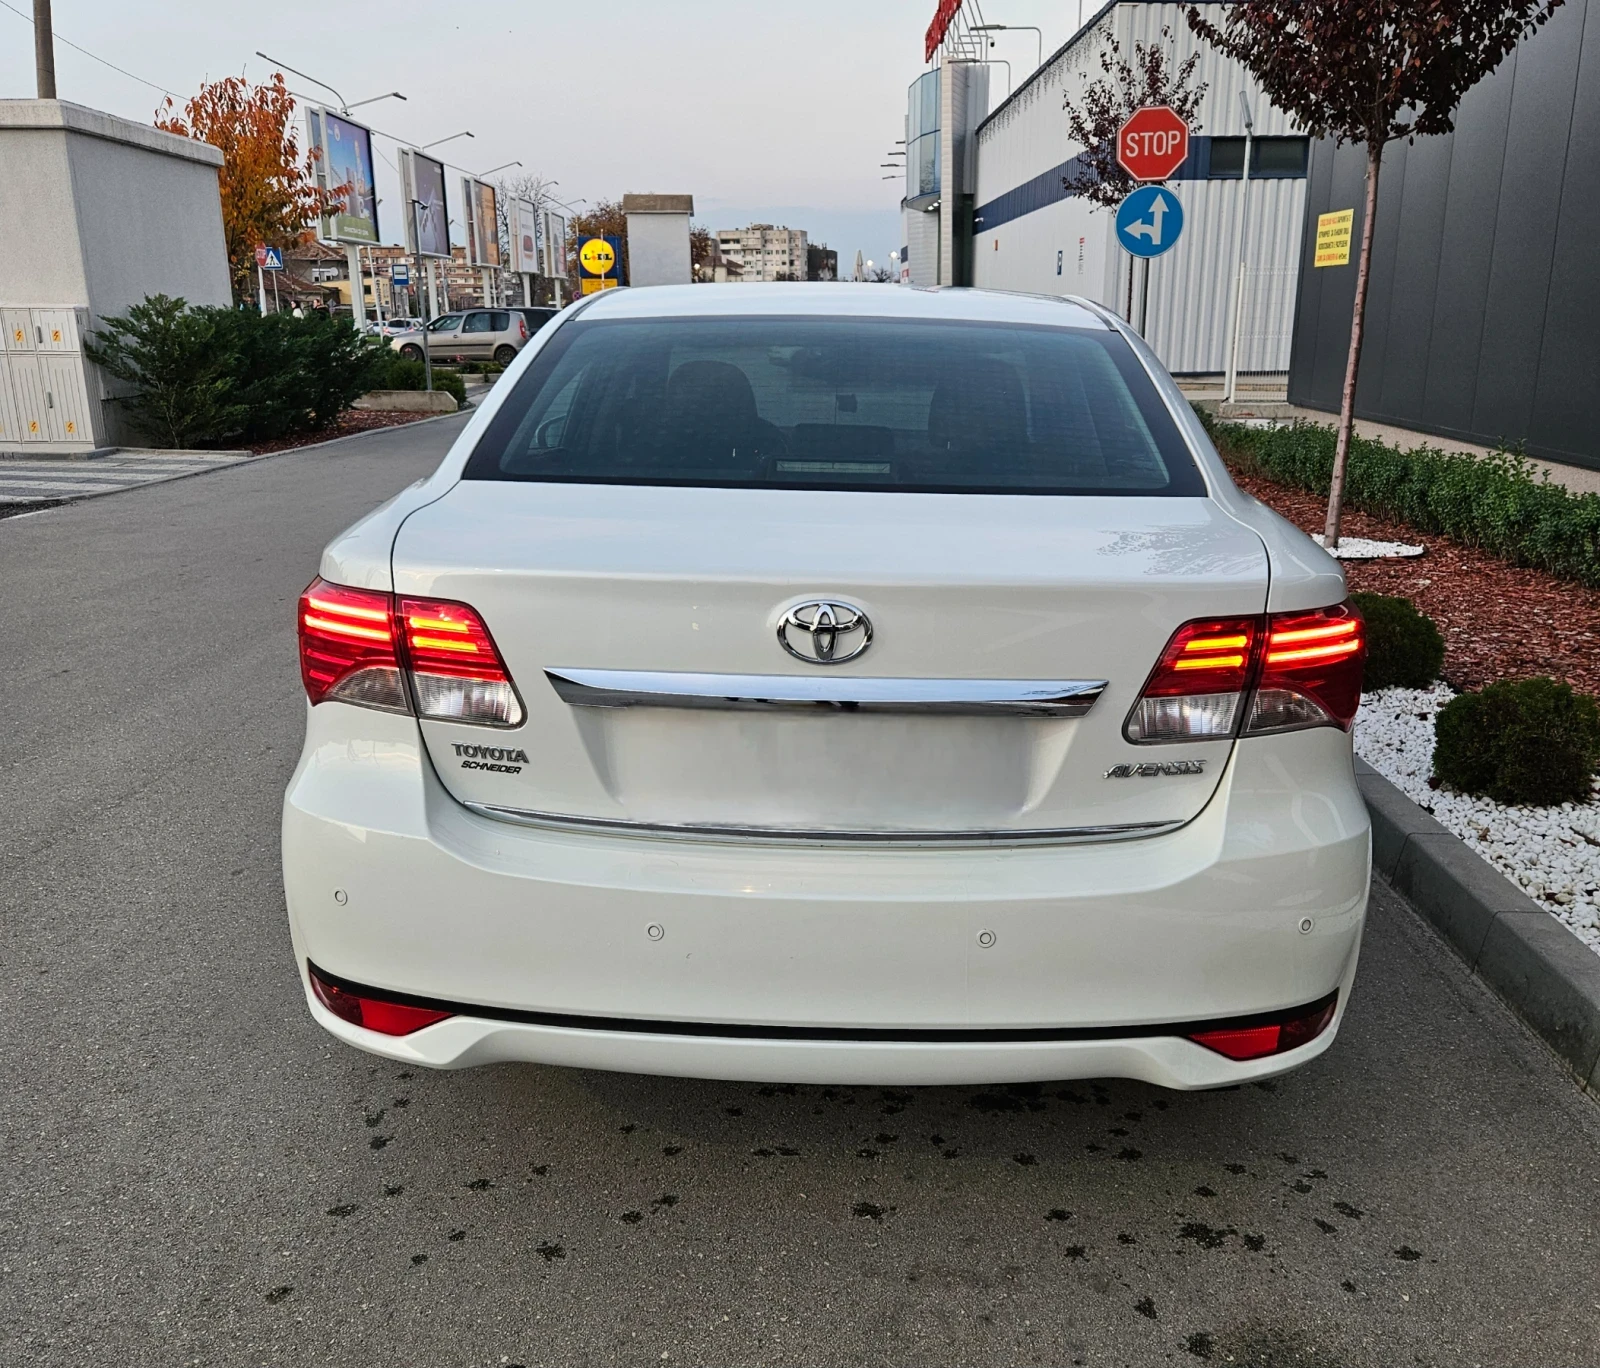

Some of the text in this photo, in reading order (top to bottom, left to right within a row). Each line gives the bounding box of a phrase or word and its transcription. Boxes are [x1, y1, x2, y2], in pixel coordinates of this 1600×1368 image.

[1125, 130, 1181, 158] STOP
[450, 740, 530, 764] TOYOTA
[461, 760, 522, 774] SCHNEIDER
[1103, 760, 1207, 779] AVENSIS
